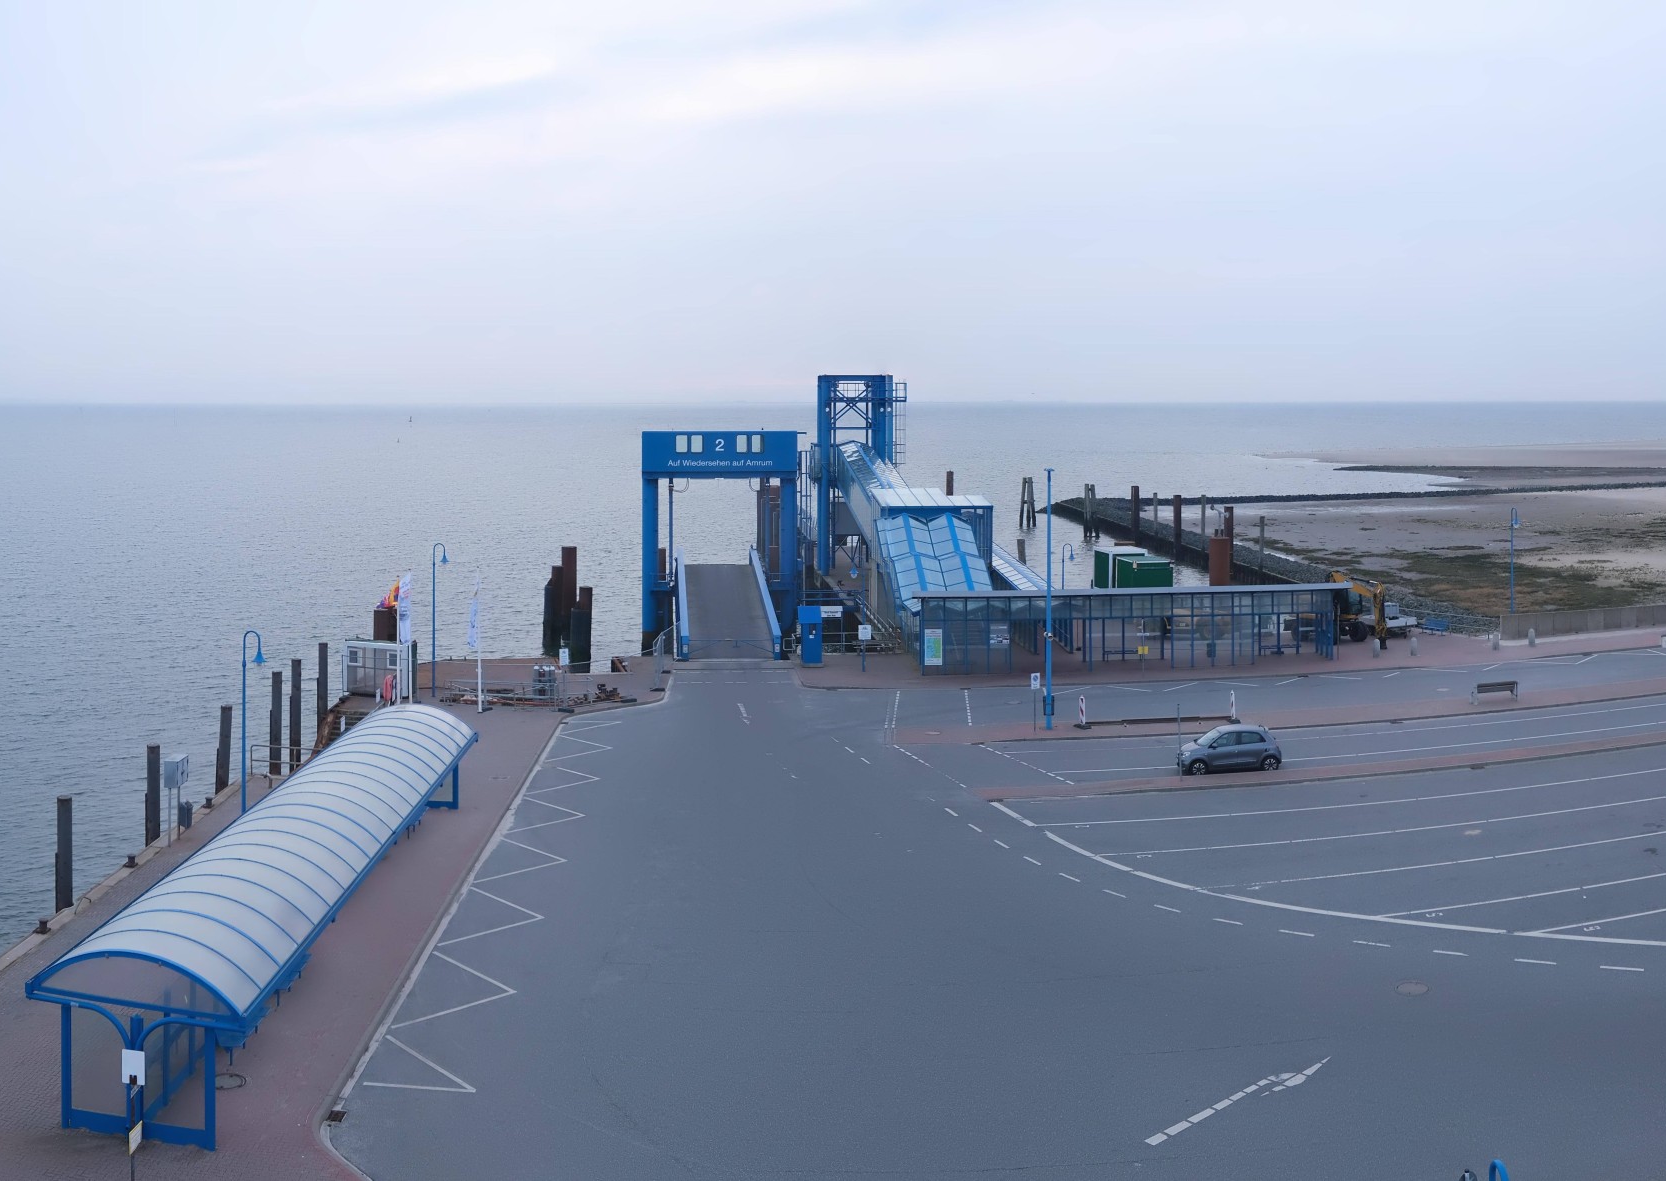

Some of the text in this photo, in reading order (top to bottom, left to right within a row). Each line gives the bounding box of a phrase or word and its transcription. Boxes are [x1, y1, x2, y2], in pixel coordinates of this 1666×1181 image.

[715, 439, 725, 451] 2
[667, 459, 773, 467] Auf Wiedersehen auf Amrum
